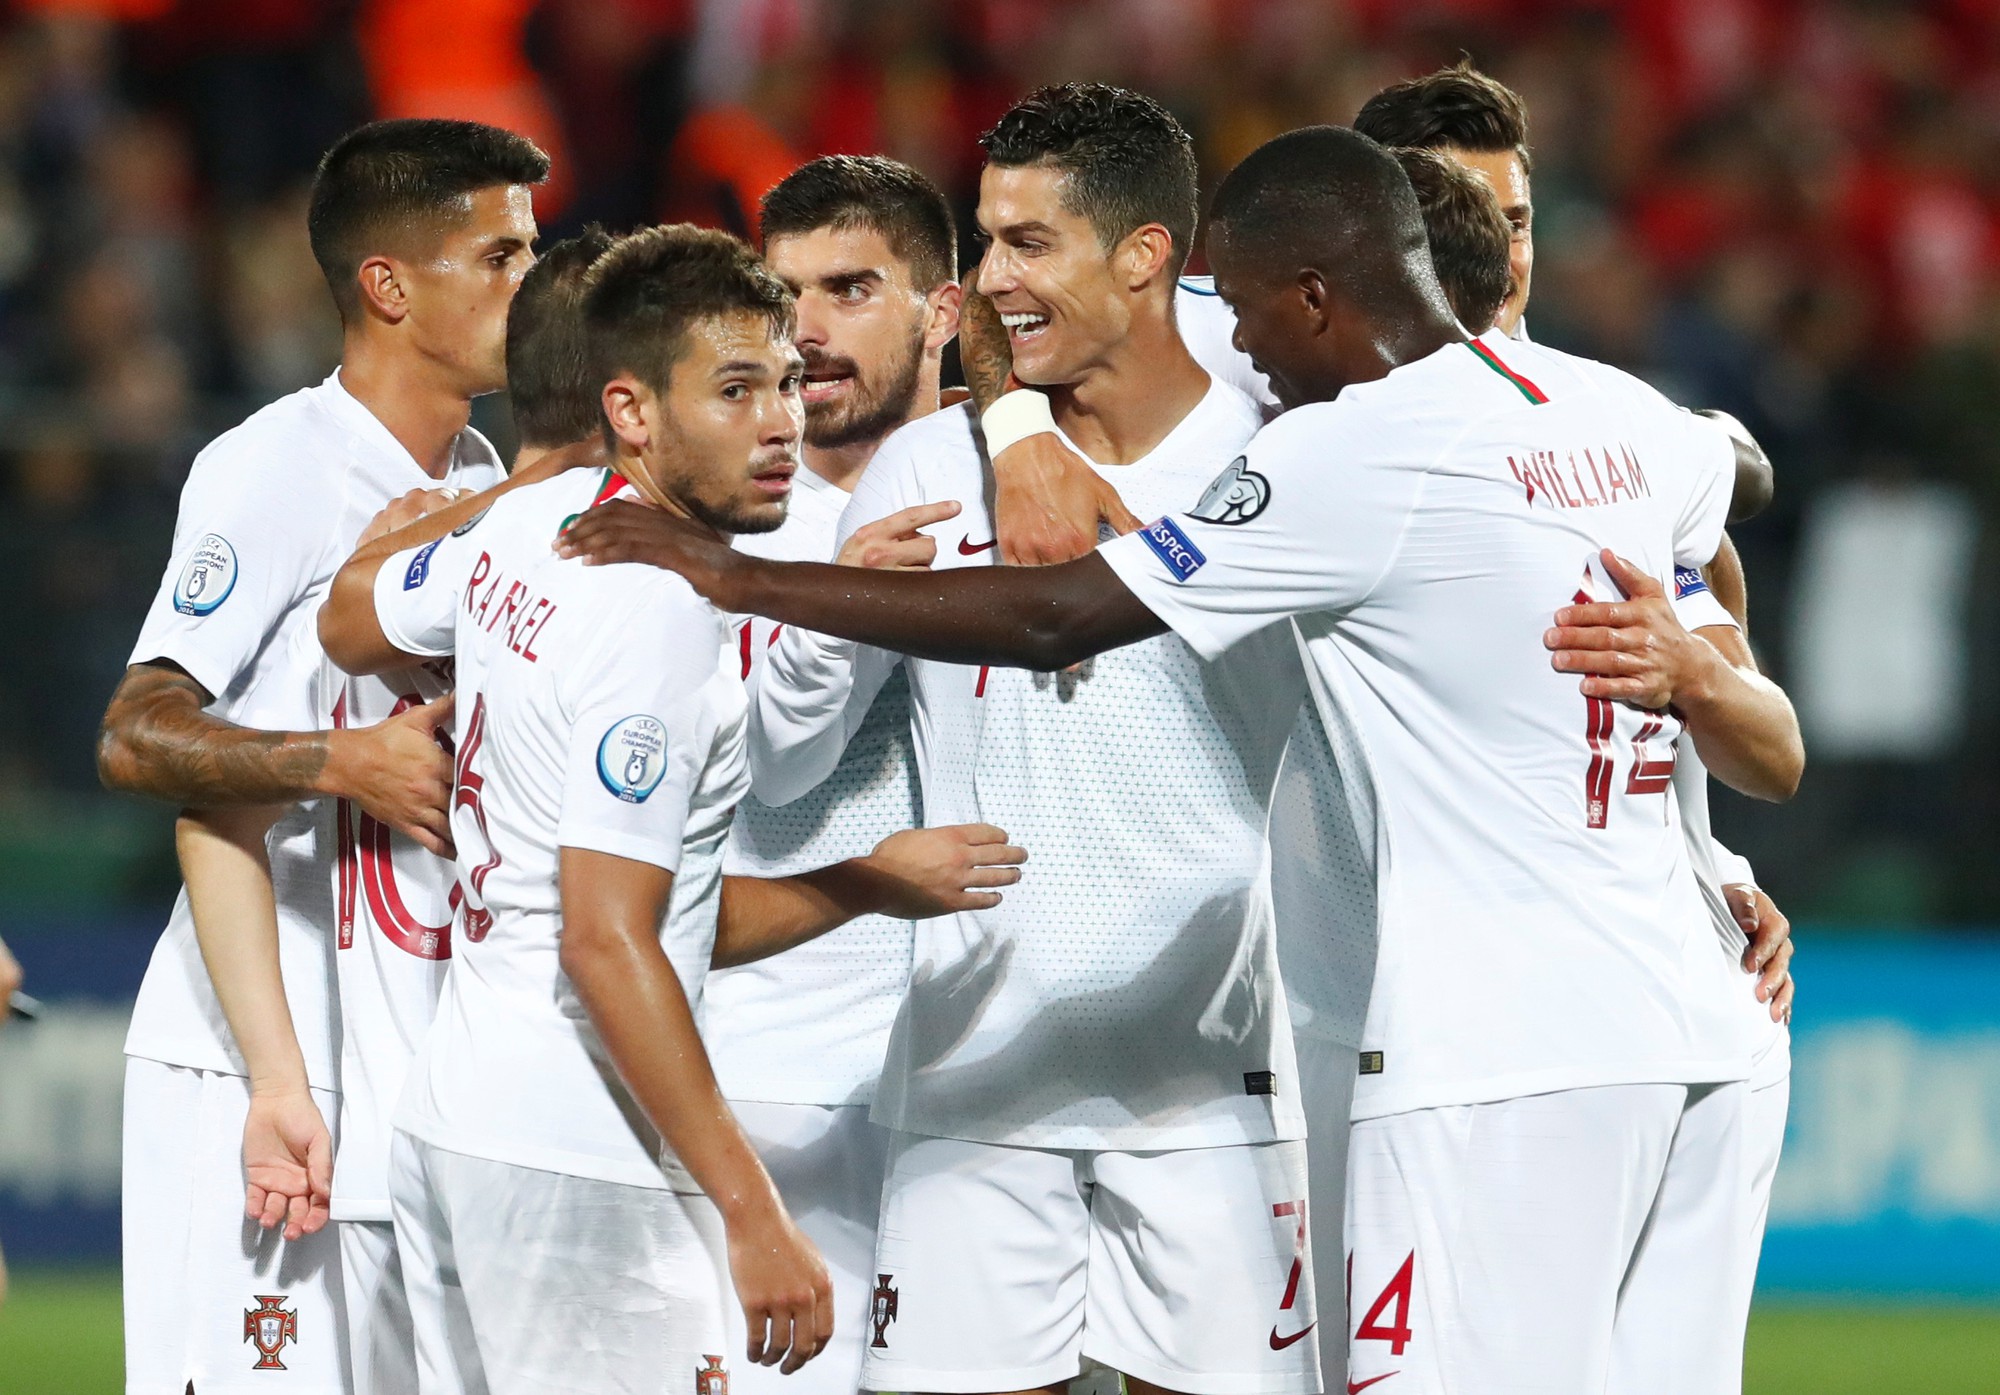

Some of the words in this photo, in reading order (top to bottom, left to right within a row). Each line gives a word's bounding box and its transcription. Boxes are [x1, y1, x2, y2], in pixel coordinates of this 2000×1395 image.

[1507, 440, 1651, 509] WILLIAM
[178, 606, 195, 615] 2016
[1273, 1199, 1305, 1310] 7
